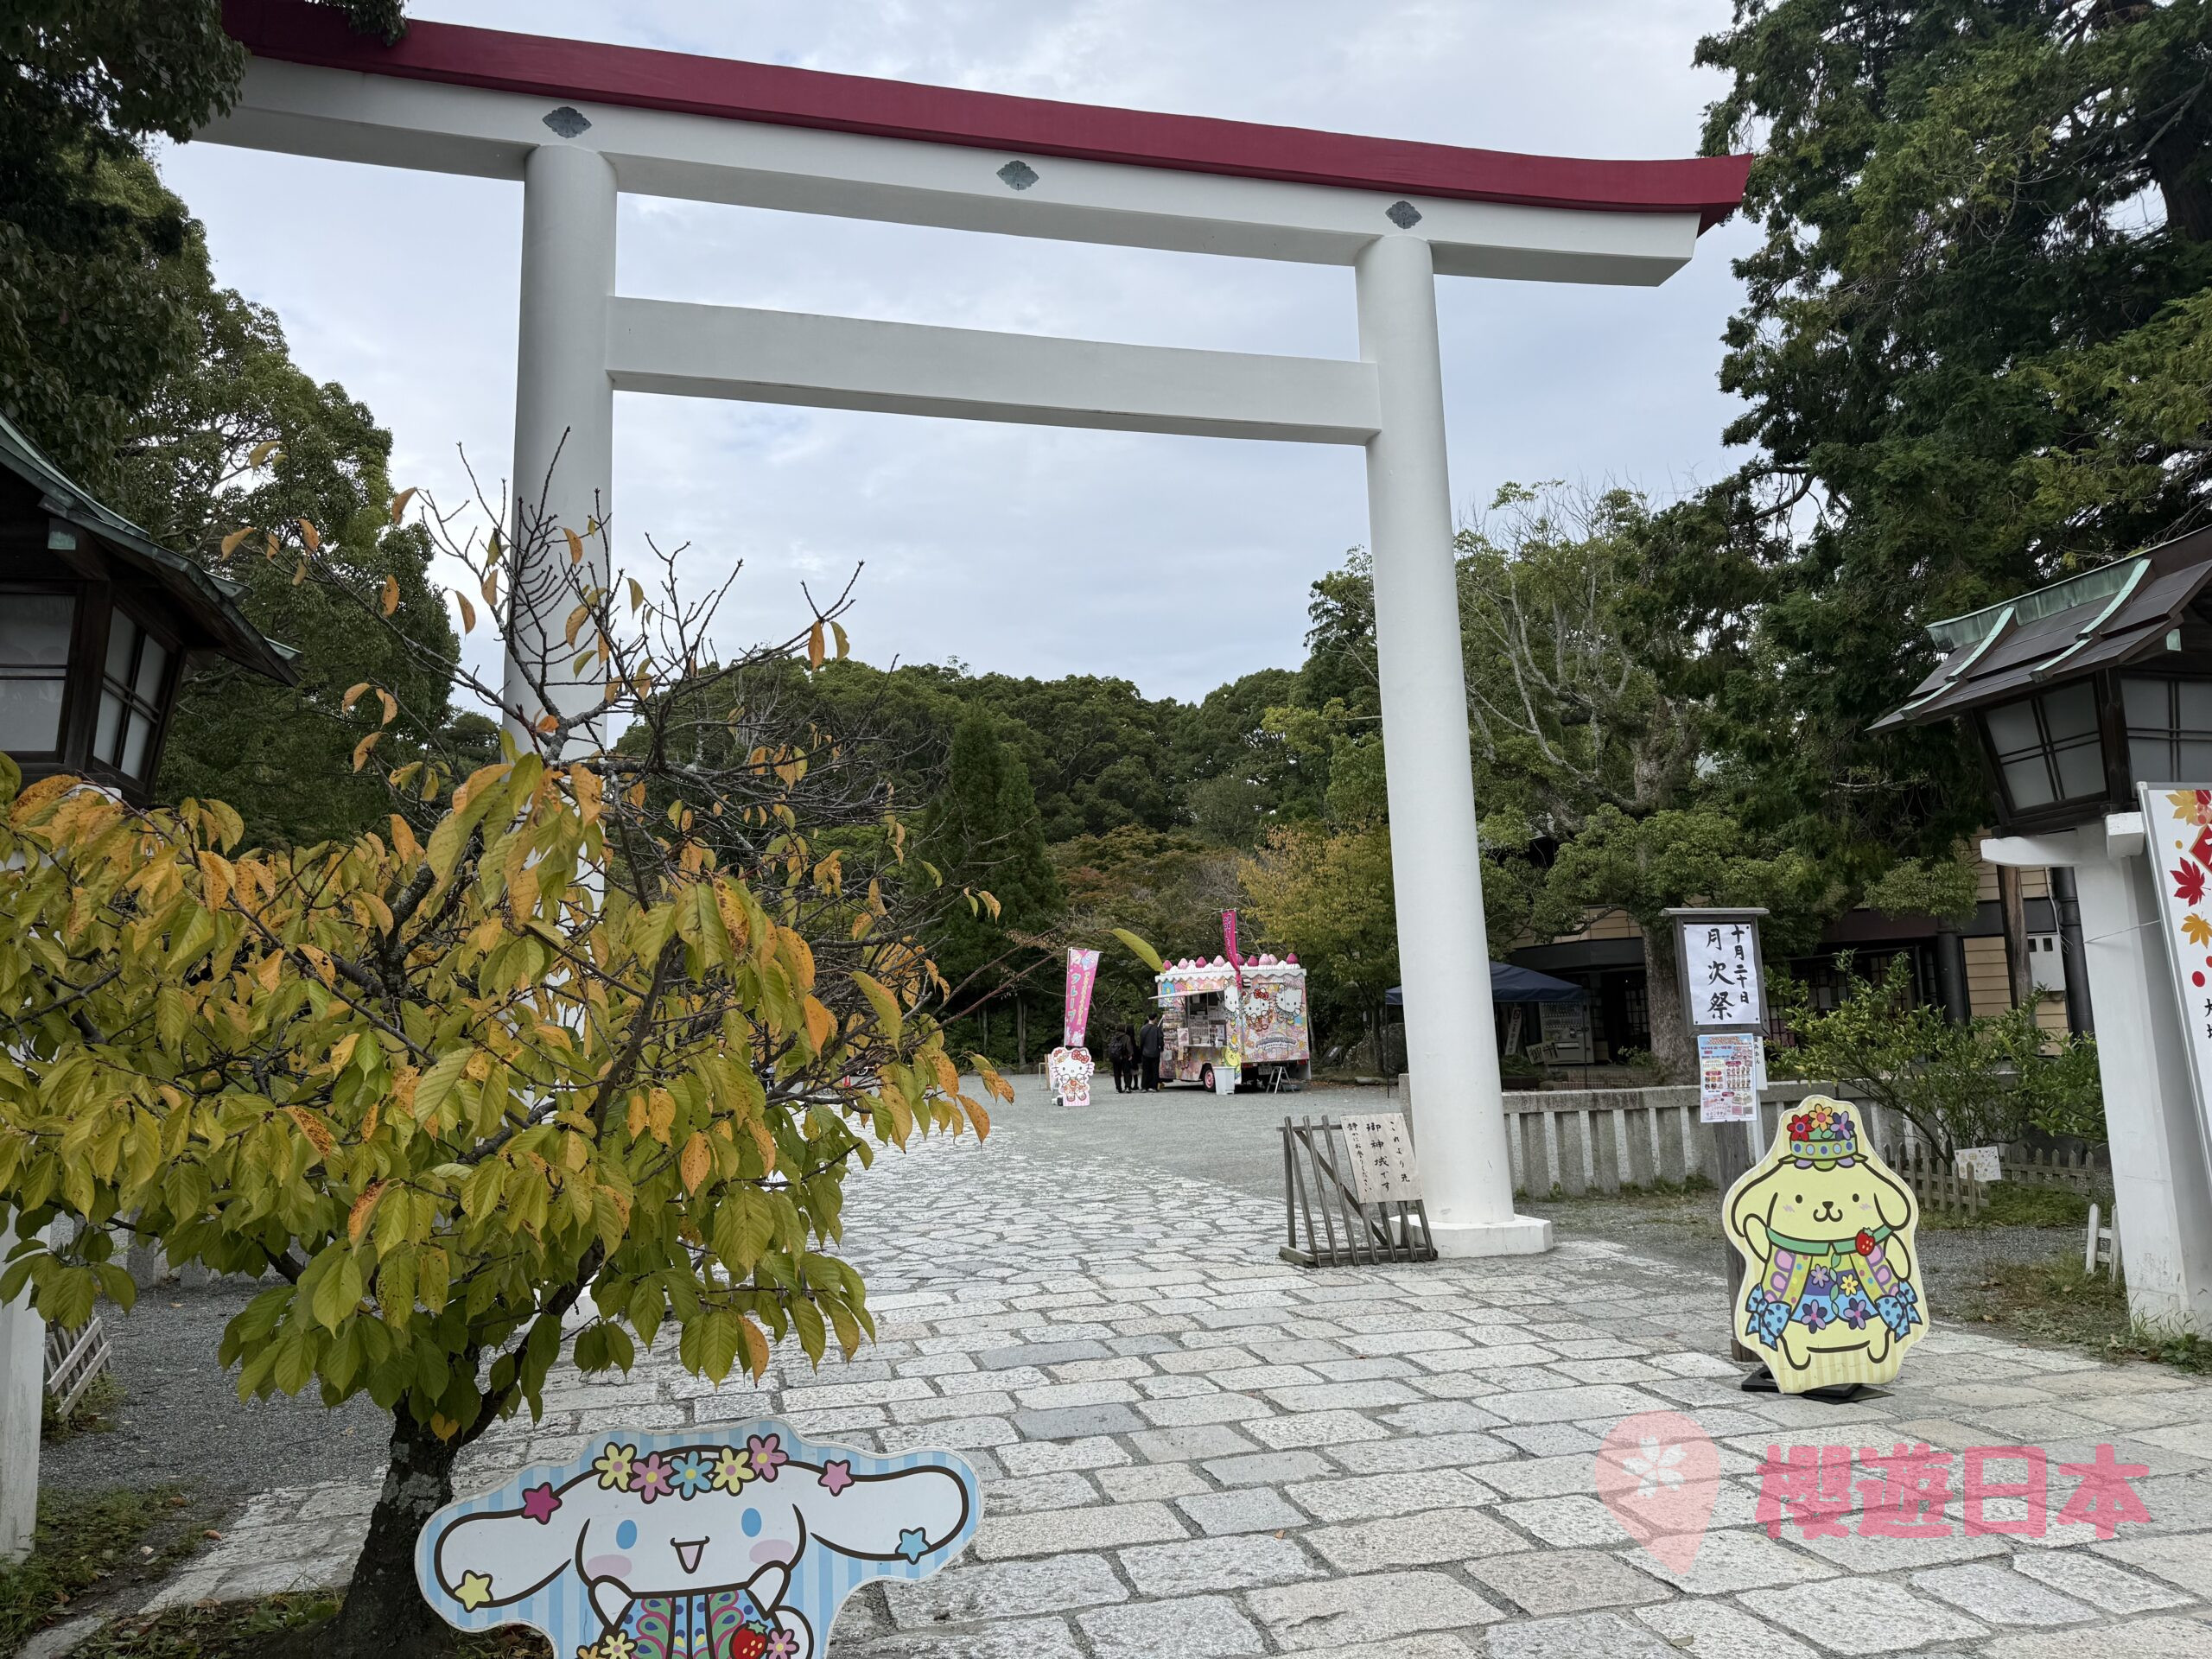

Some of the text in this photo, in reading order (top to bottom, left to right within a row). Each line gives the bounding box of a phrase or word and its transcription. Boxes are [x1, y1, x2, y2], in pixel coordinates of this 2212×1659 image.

[1706, 927, 1736, 1020] 月次祭
[1731, 925, 1750, 1004] 十月二十日
[1365, 1122, 1390, 1192] 御神域です
[1389, 1121, 1411, 1183] これより先
